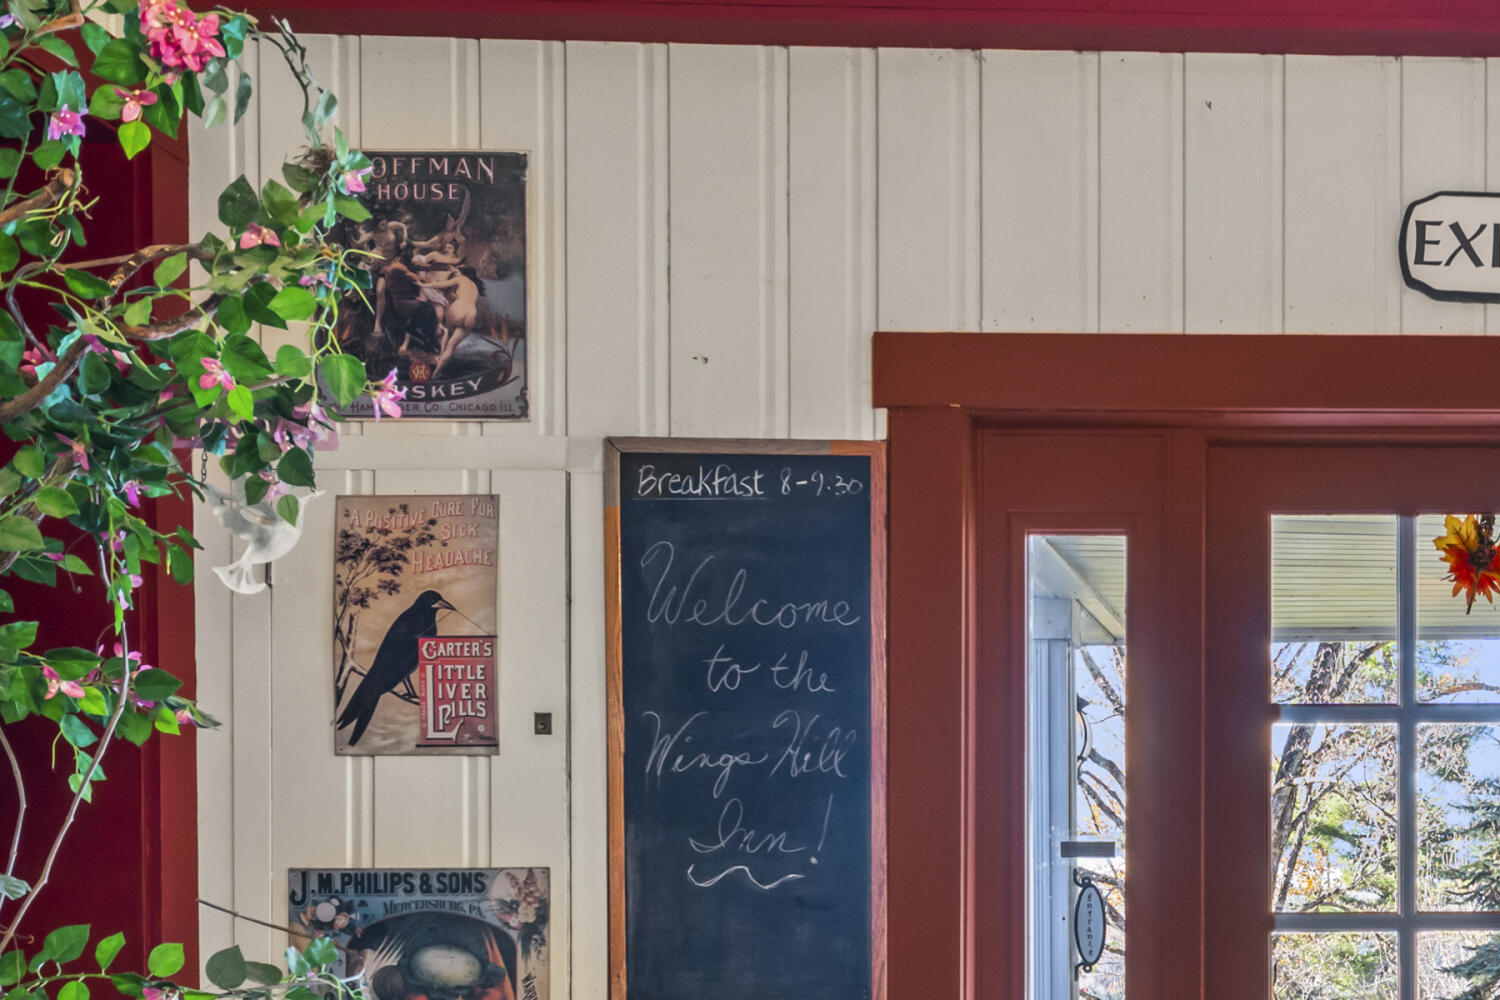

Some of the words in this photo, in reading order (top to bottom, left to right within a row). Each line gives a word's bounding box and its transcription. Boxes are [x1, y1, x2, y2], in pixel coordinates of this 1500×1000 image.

[371, 156, 494, 185] OFFMAN
[377, 182, 460, 201] HOUSE
[637, 464, 765, 497] Breakfast
[350, 509, 363, 529] A
[365, 509, 428, 530] POSITIVE
[431, 500, 465, 519] CURE
[471, 497, 496, 519] FOR
[440, 522, 480, 542] SICK
[640, 540, 861, 629] Welcome
[422, 640, 493, 660] CARTER'S
[702, 643, 761, 692] to
[770, 650, 836, 692] the
[438, 701, 488, 731] PILLS
[641, 710, 769, 799] Wings
[768, 709, 857, 778] Hill
[419, 872, 433, 895] &
[436, 872, 487, 895] SONS
